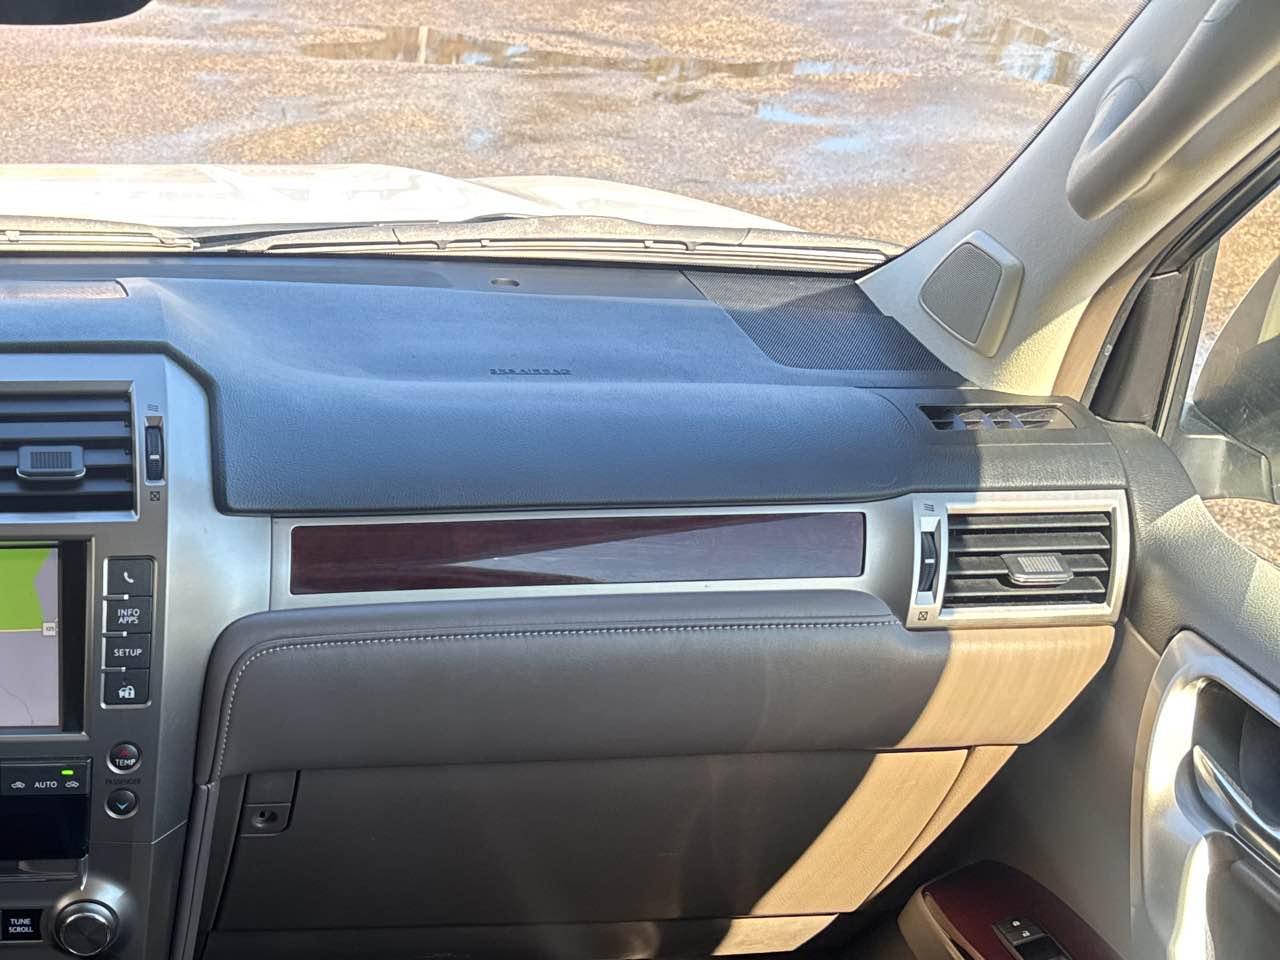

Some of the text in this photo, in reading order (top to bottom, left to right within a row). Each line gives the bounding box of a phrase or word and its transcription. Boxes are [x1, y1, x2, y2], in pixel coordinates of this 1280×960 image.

[117, 608, 140, 617] INFO
[118, 616, 139, 625] APPS
[113, 648, 142, 657] SETUP
[115, 758, 136, 767] TEMP
[34, 780, 58, 789] AUTO
[10, 918, 31, 926] TUNE
[8, 925, 34, 934] SCROLL
